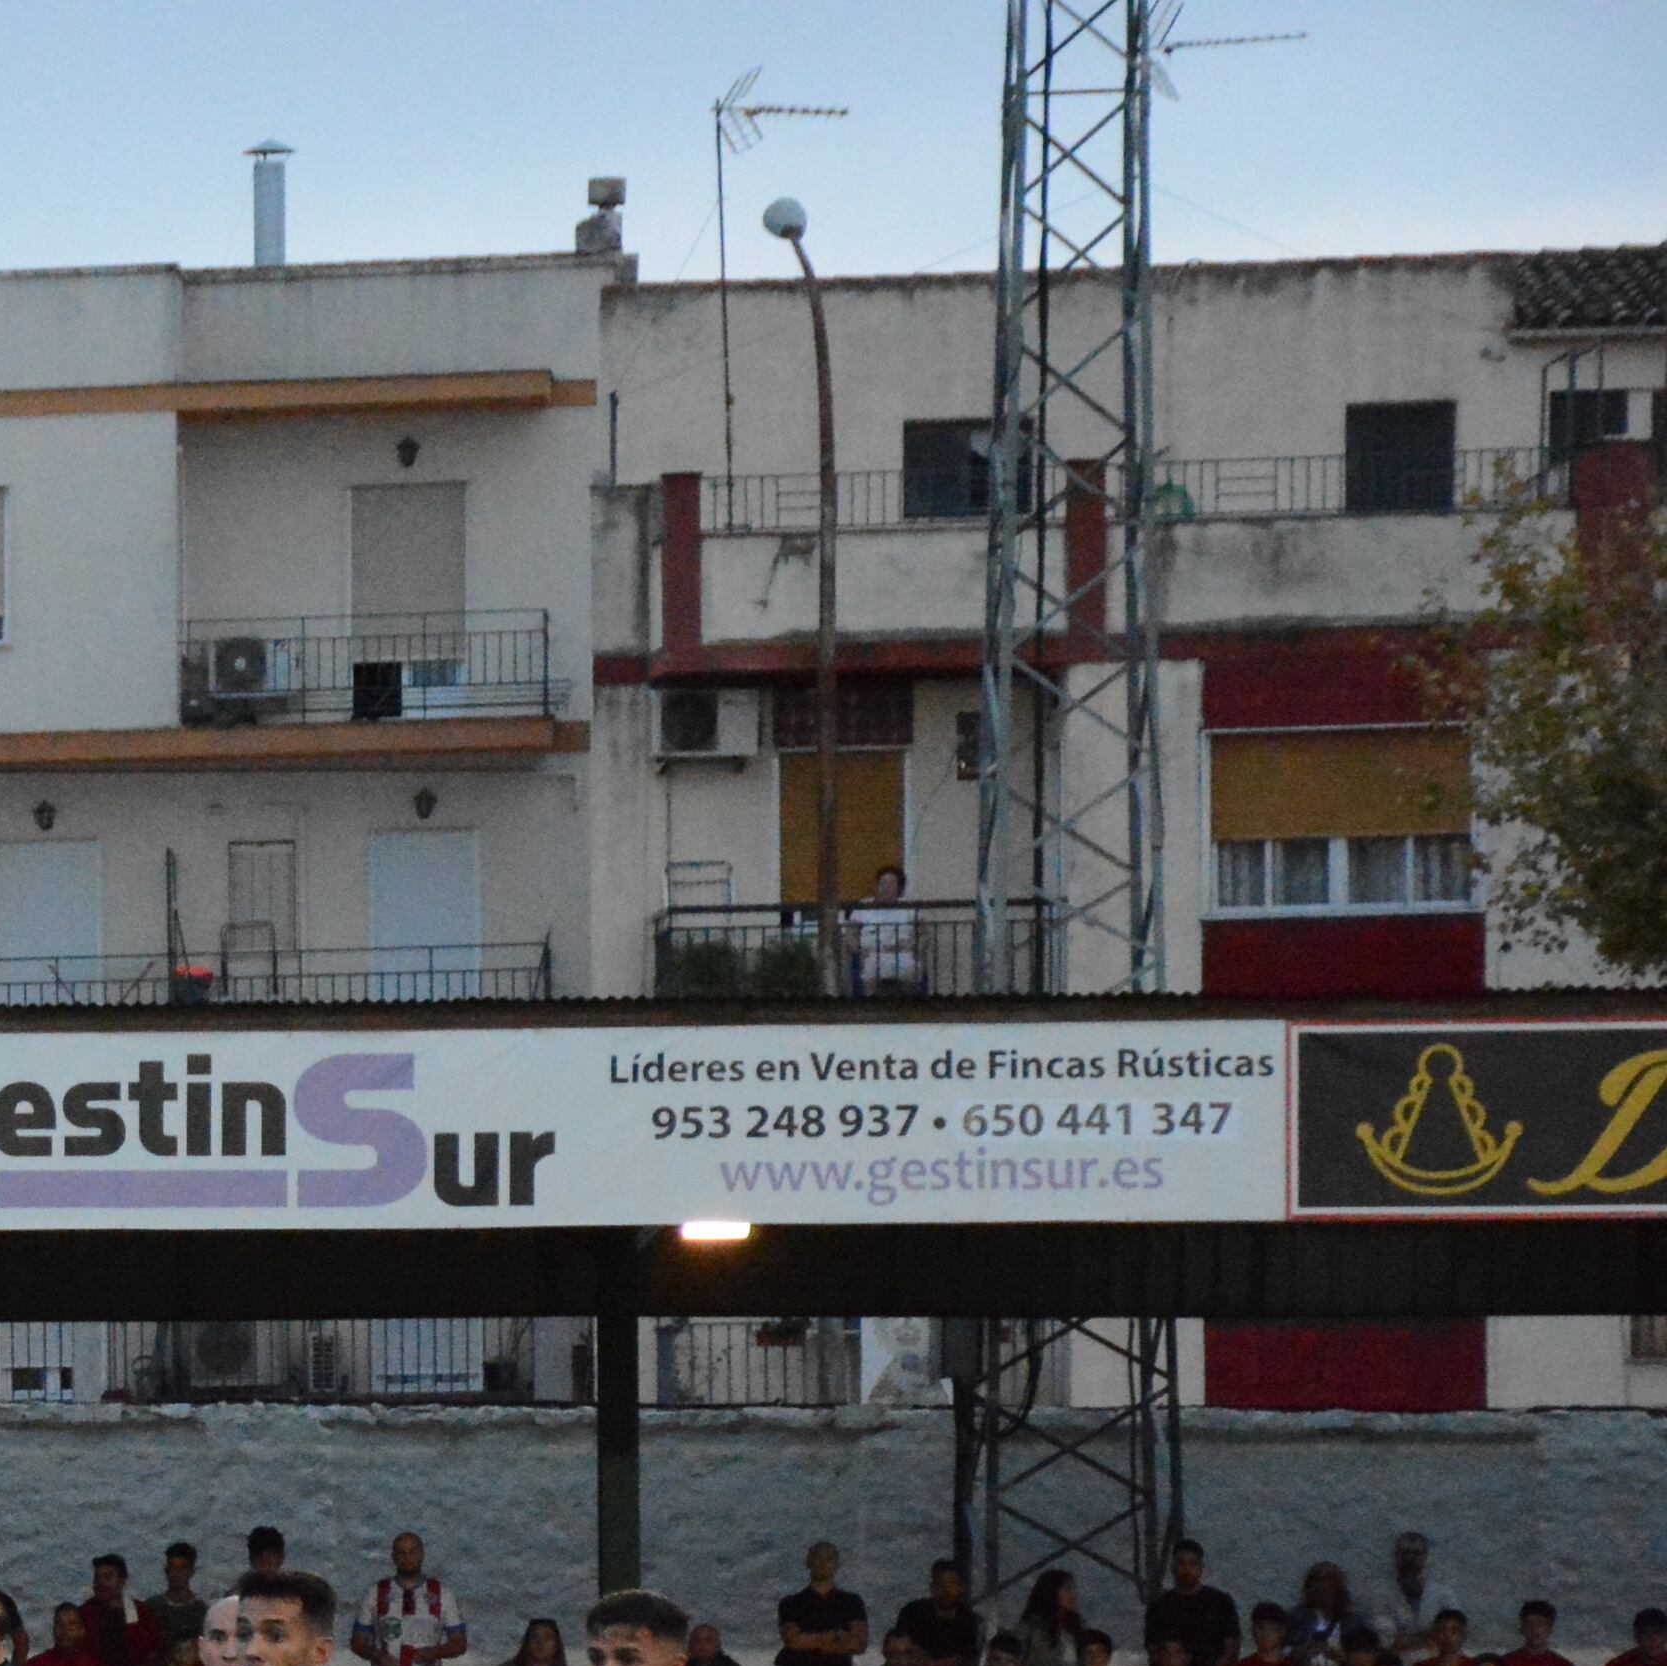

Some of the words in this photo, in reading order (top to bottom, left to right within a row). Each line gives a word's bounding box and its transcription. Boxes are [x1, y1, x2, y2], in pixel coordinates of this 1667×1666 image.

[610, 1053, 745, 1084] Líderes
[756, 1059, 800, 1081] en
[810, 1052, 918, 1081] Venta
[930, 1049, 976, 1079] de
[988, 1049, 1105, 1079] Fincas
[1117, 1048, 1275, 1078] Rústicas
[651, 1105, 732, 1140] 953
[746, 1104, 826, 1138] 248
[838, 1104, 919, 1138] 937
[962, 1103, 1044, 1137] 650
[1056, 1103, 1133, 1136] 441
[1152, 1102, 1233, 1136] 347
[720, 1146, 1165, 1207] www.gestinsur.es
